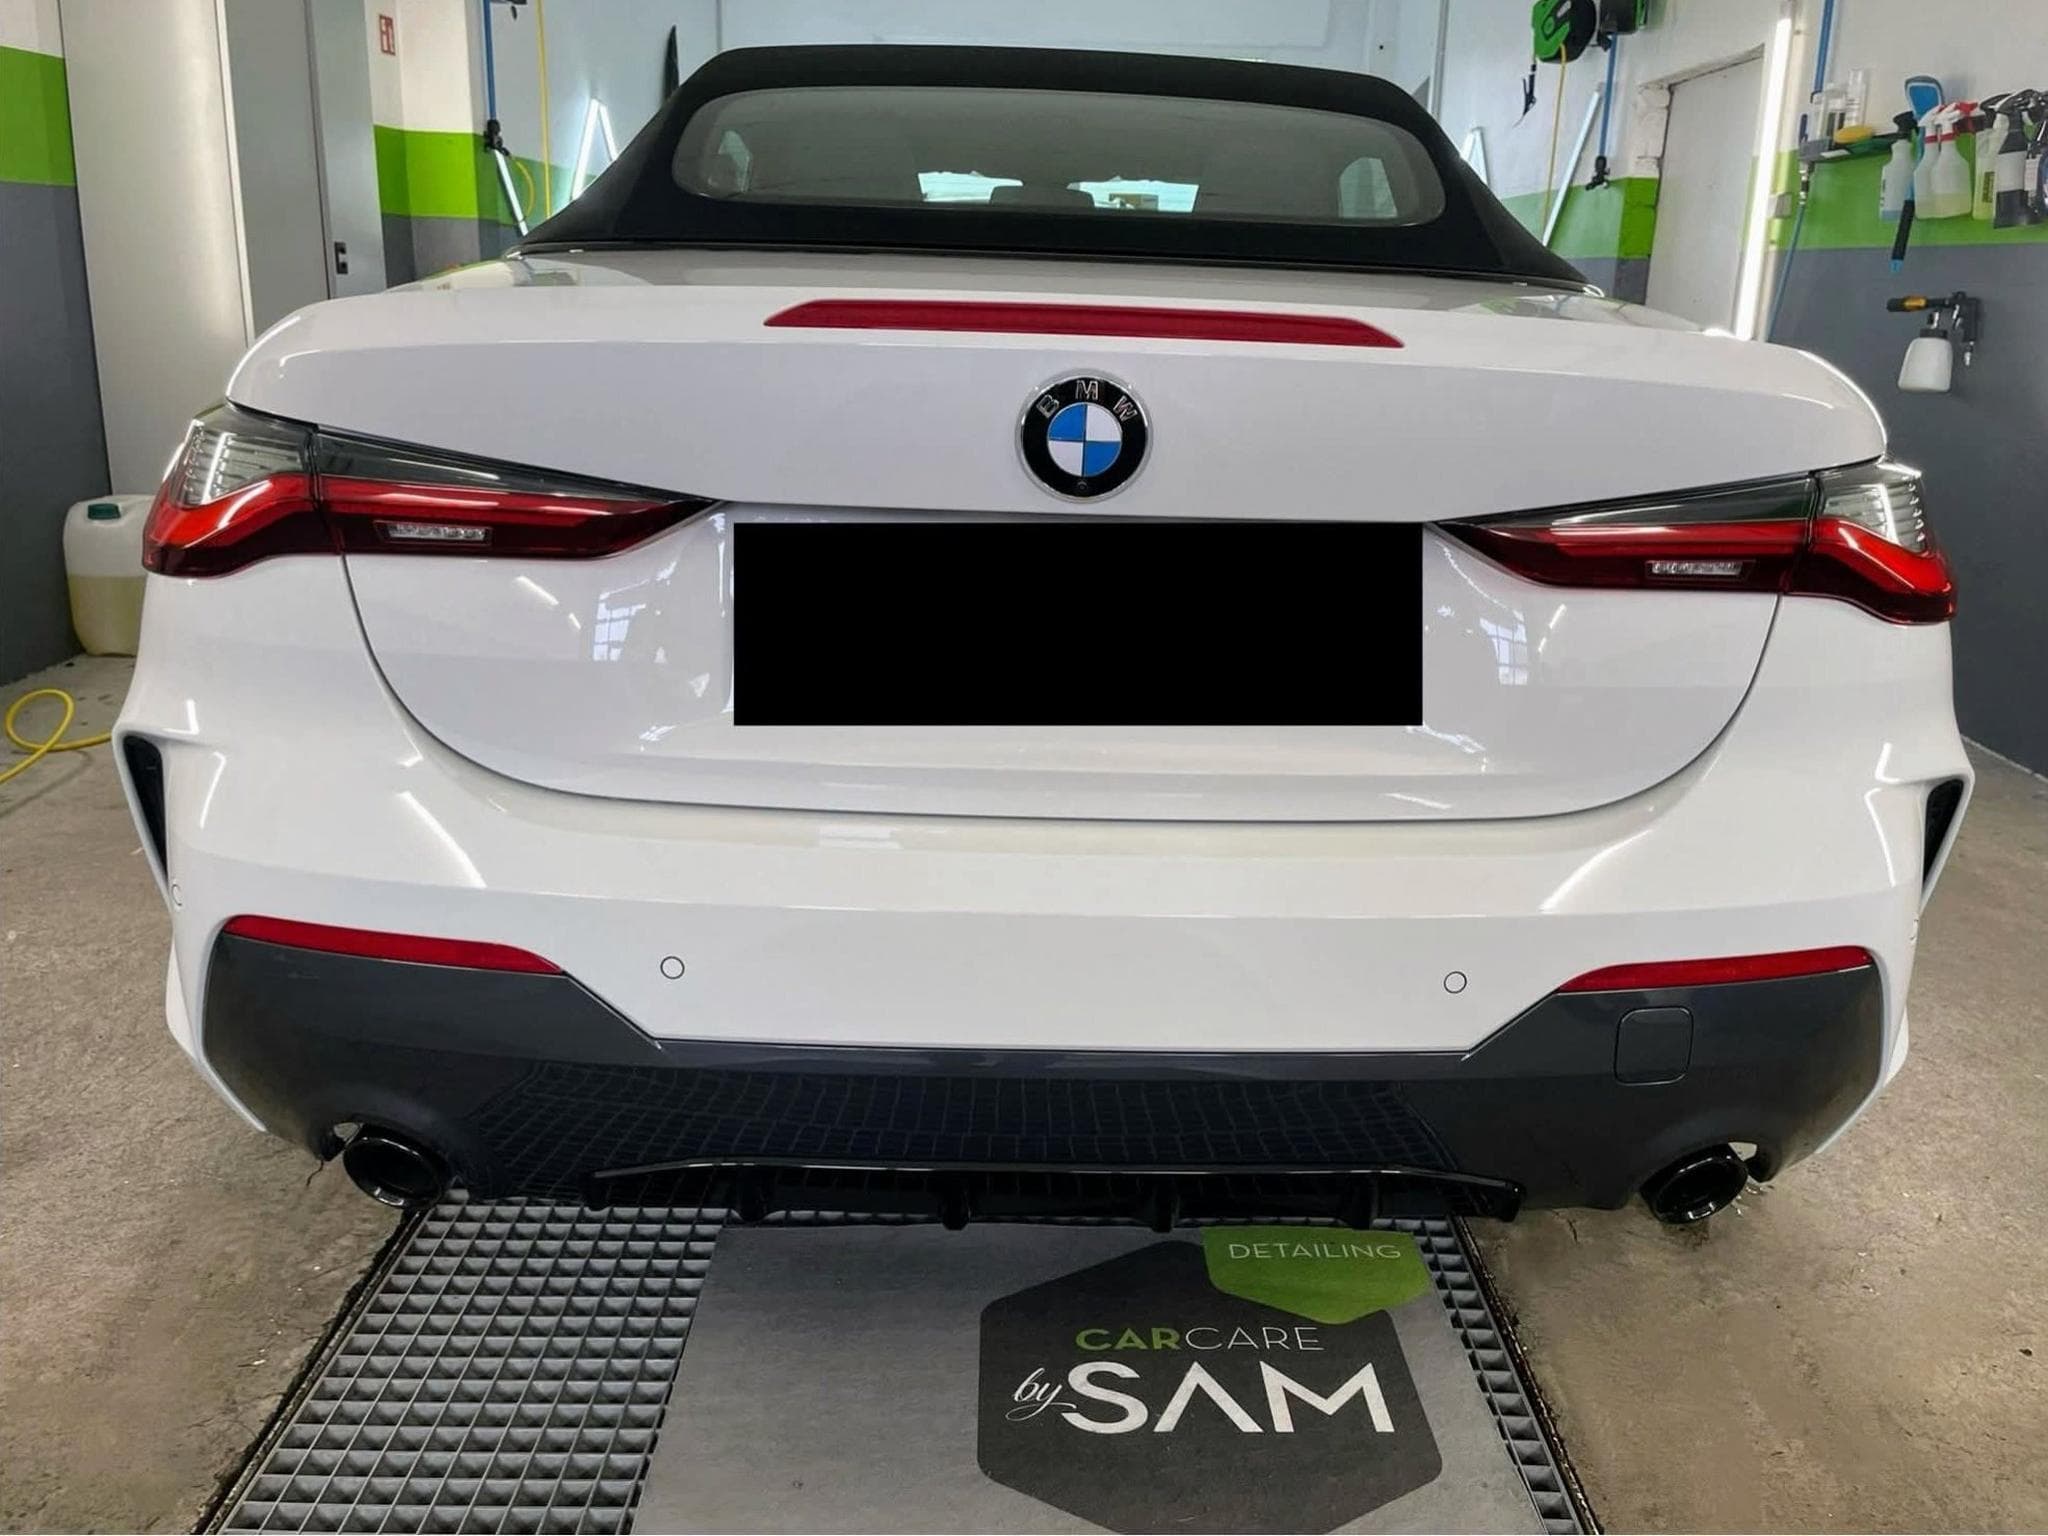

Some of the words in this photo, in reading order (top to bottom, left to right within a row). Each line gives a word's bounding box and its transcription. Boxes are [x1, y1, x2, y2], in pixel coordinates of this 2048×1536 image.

[1036, 379, 1138, 422] BMW
[1228, 1243, 1401, 1260] DETAILING
[1005, 1367, 1077, 1422] by
[1060, 1360, 1396, 1435] SAM
